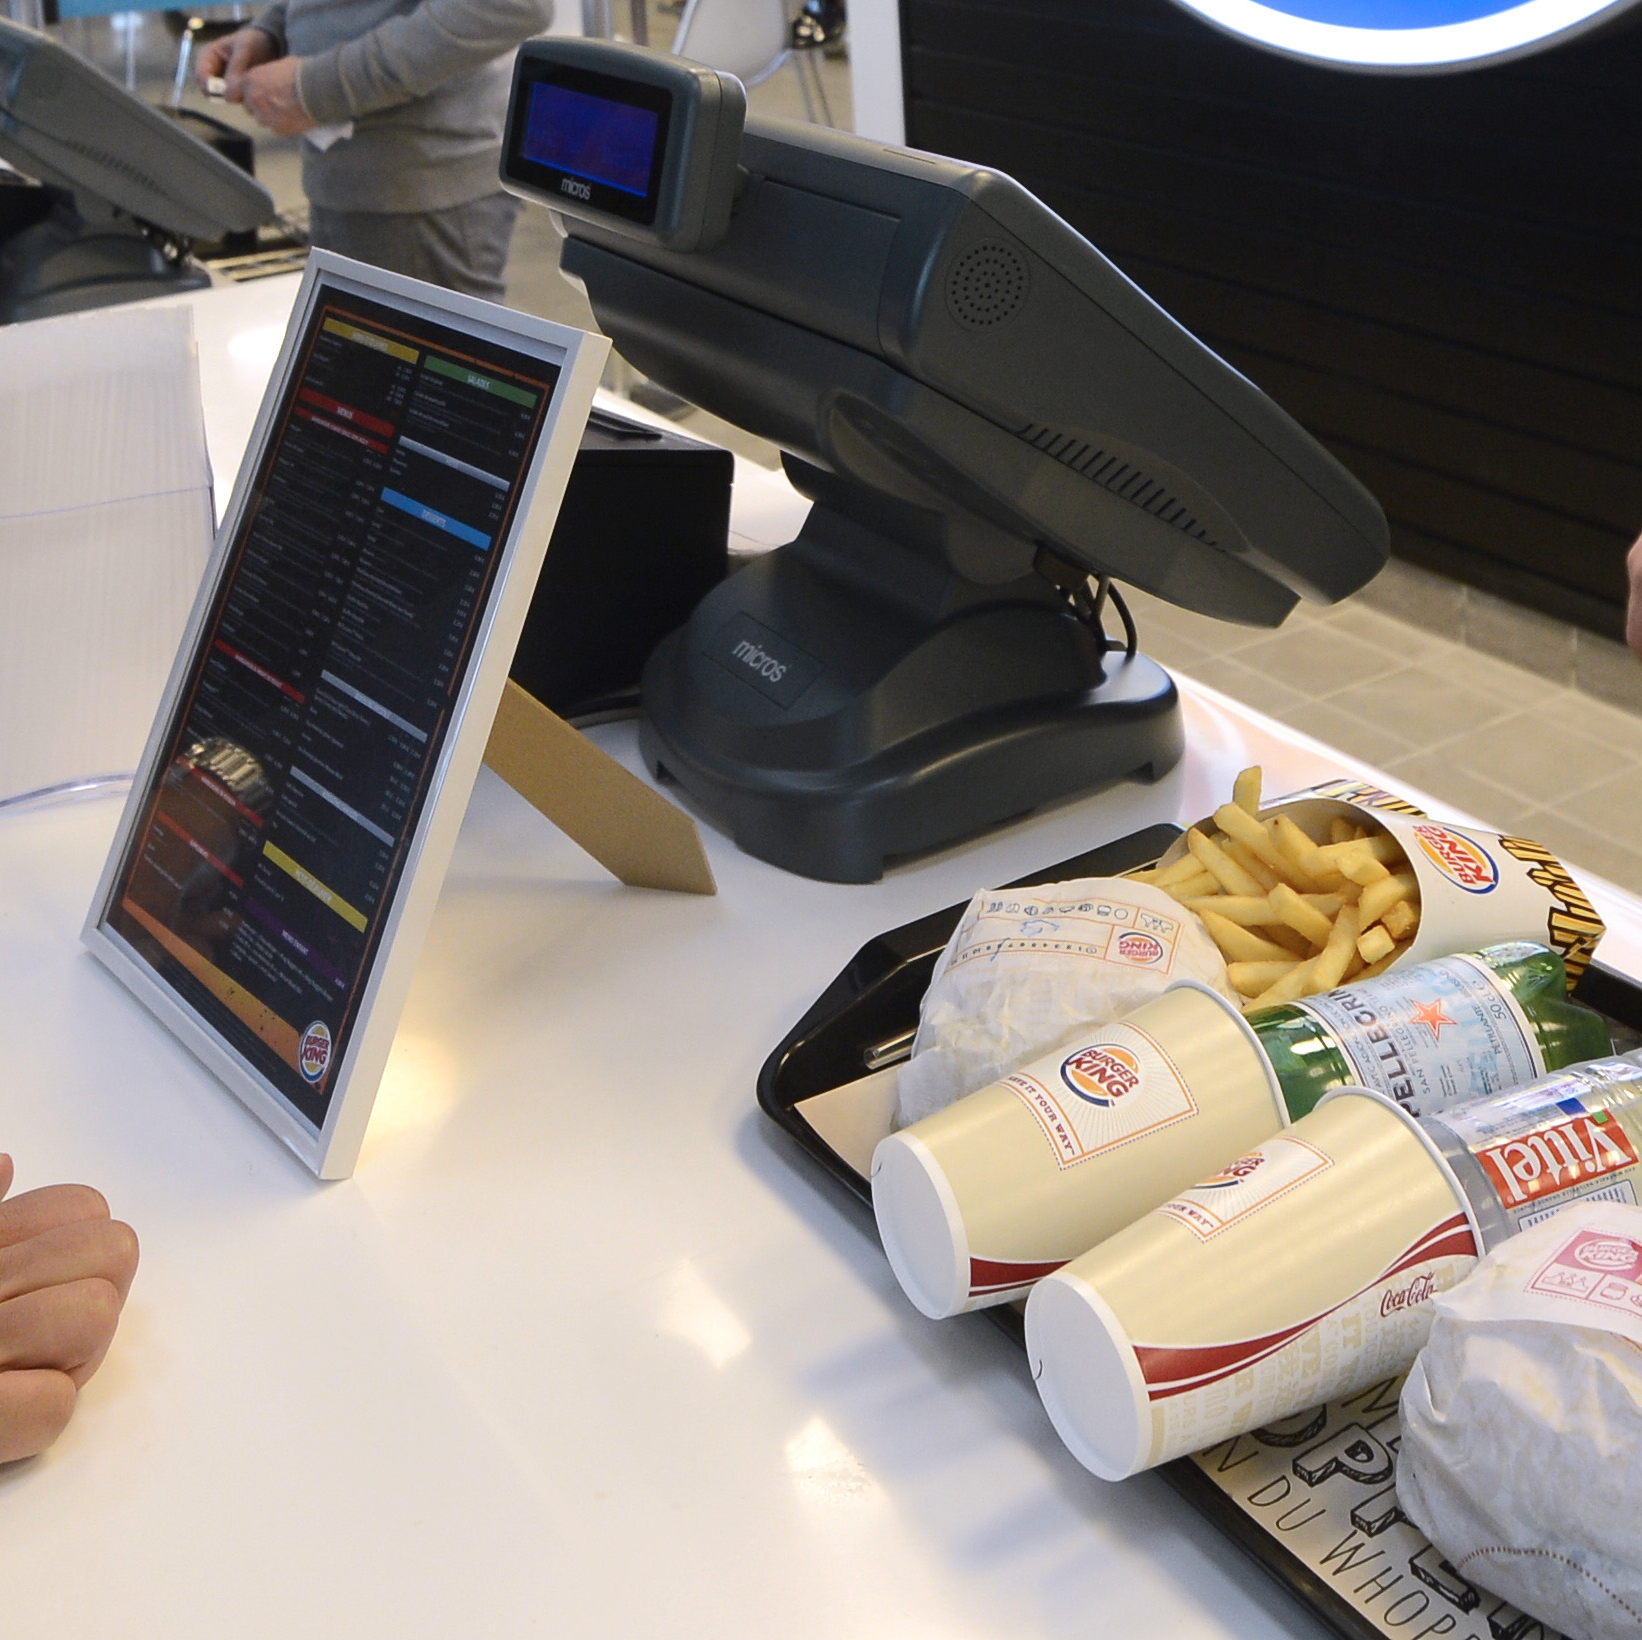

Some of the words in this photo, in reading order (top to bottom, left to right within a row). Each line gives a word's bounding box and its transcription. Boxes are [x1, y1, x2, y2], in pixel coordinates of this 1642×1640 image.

[560, 176, 591, 201] micros
[730, 639, 787, 683] micros
[1412, 825, 1477, 884] BURGER
[1424, 826, 1495, 884] KING
[1118, 940, 1159, 952] KING
[1118, 948, 1159, 959] BURGER
[1489, 1003, 1507, 1020] 50
[301, 1043, 328, 1066] KING
[306, 1031, 330, 1050] BURGER
[1067, 1056, 1130, 1098] KING
[1082, 1049, 1140, 1089] BURGER
[1026, 1084, 1037, 1095] IT
[1034, 1094, 1058, 1123] YOUR
[1486, 1118, 1632, 1203] Vittel
[1246, 1475, 1327, 1532] DU
[1319, 1529, 1481, 1640] WHOP
